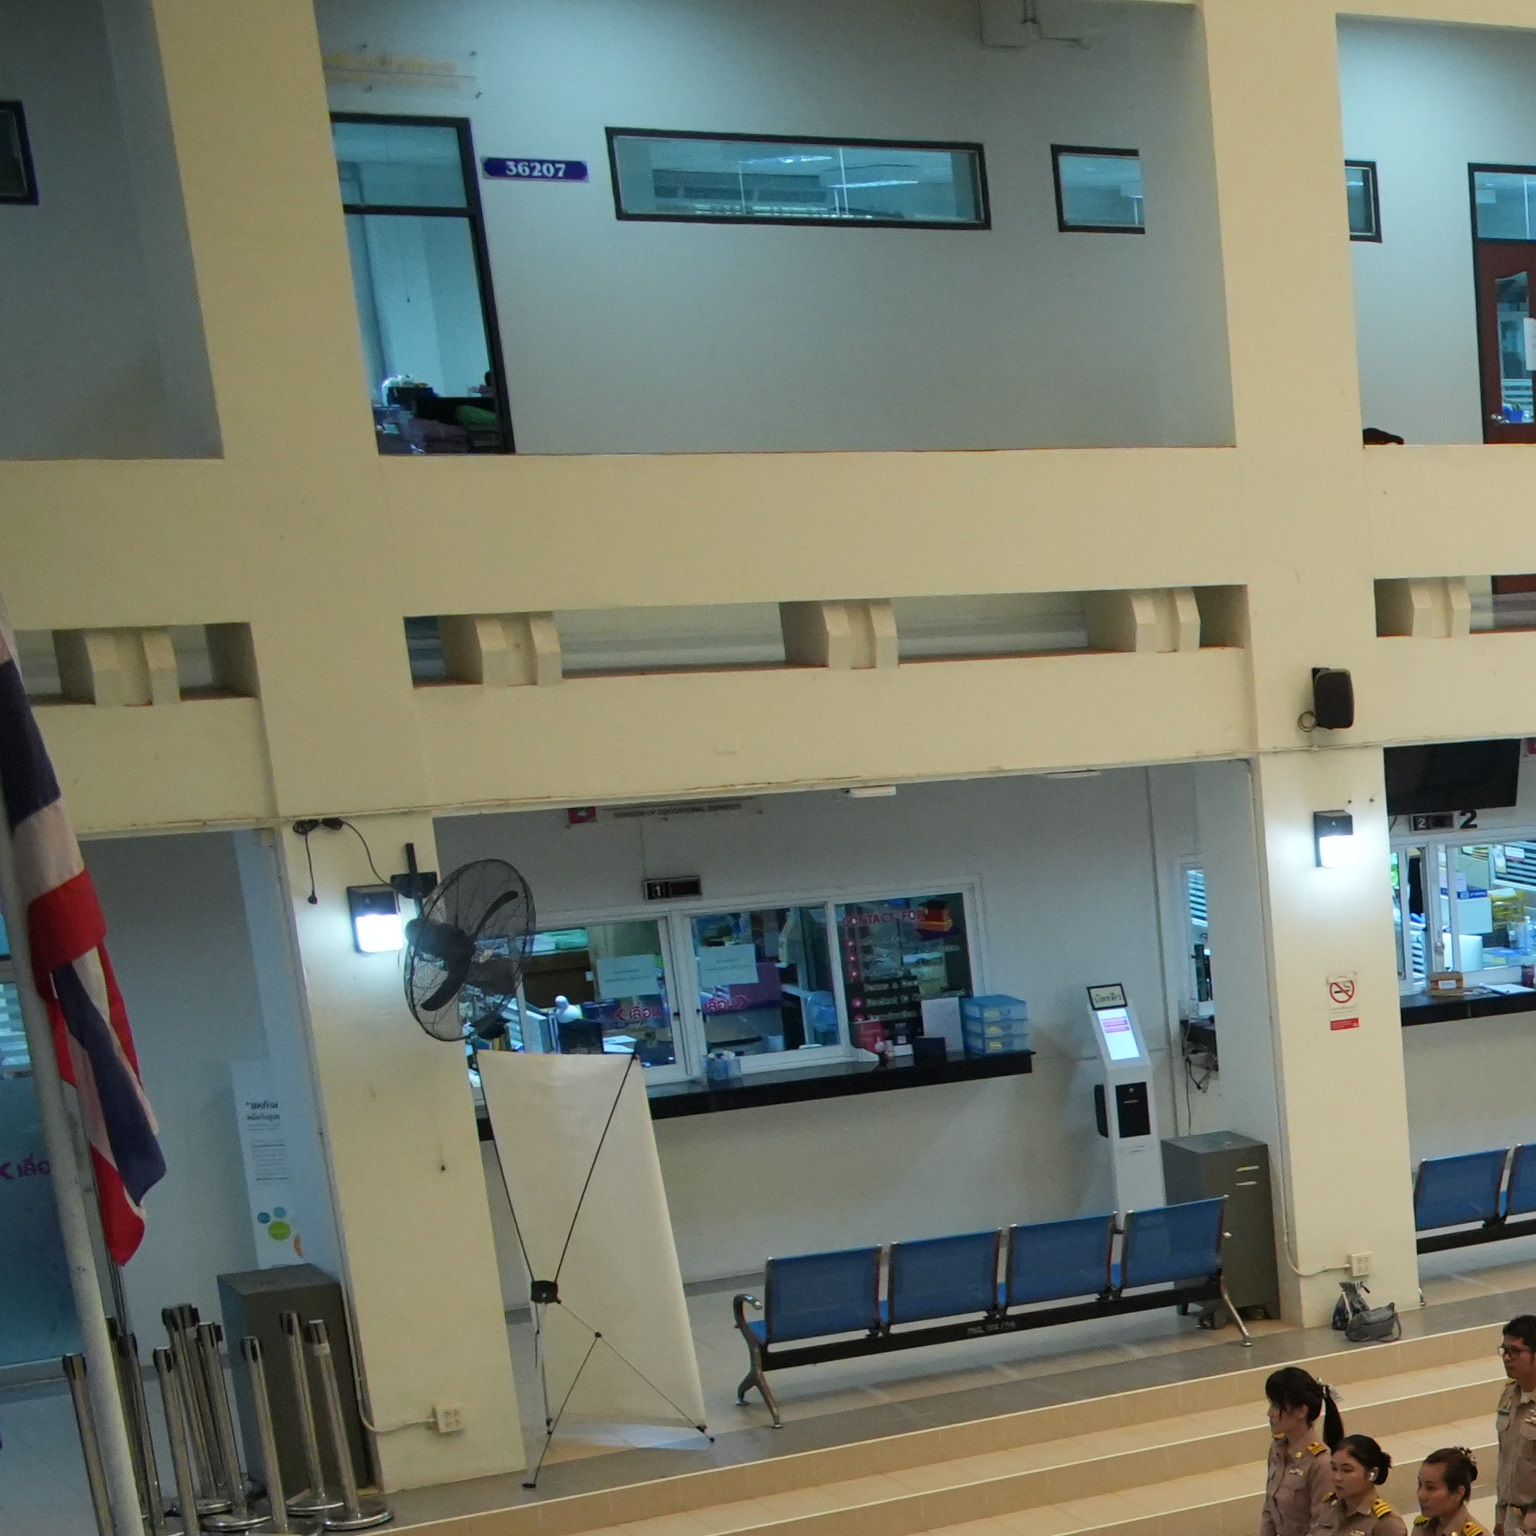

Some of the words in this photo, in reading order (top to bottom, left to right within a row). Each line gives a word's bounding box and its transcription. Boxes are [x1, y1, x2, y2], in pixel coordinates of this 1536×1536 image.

[505, 160, 567, 177] 36207
[1418, 818, 1426, 829] 2
[1460, 809, 1478, 829] 2
[655, 885, 661, 896] 1
[843, 912, 897, 928] CONTACT
